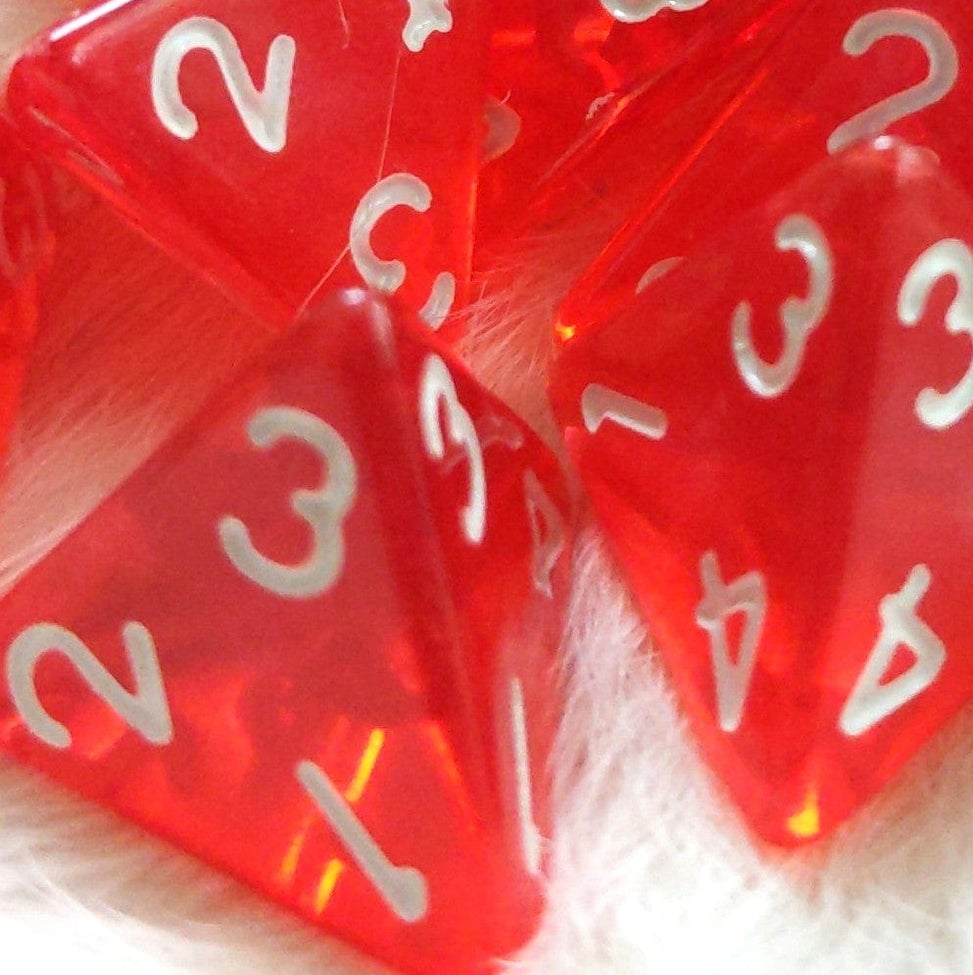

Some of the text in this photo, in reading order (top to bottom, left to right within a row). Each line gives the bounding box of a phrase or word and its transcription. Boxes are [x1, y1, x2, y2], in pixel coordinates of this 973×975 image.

[151, 16, 296, 152] 2
[731, 215, 834, 397] 3
[220, 406, 358, 599] 3
[6, 620, 174, 747] 2
[697, 552, 767, 732] 4
[838, 563, 947, 735] 4
[296, 759, 430, 923] 1
